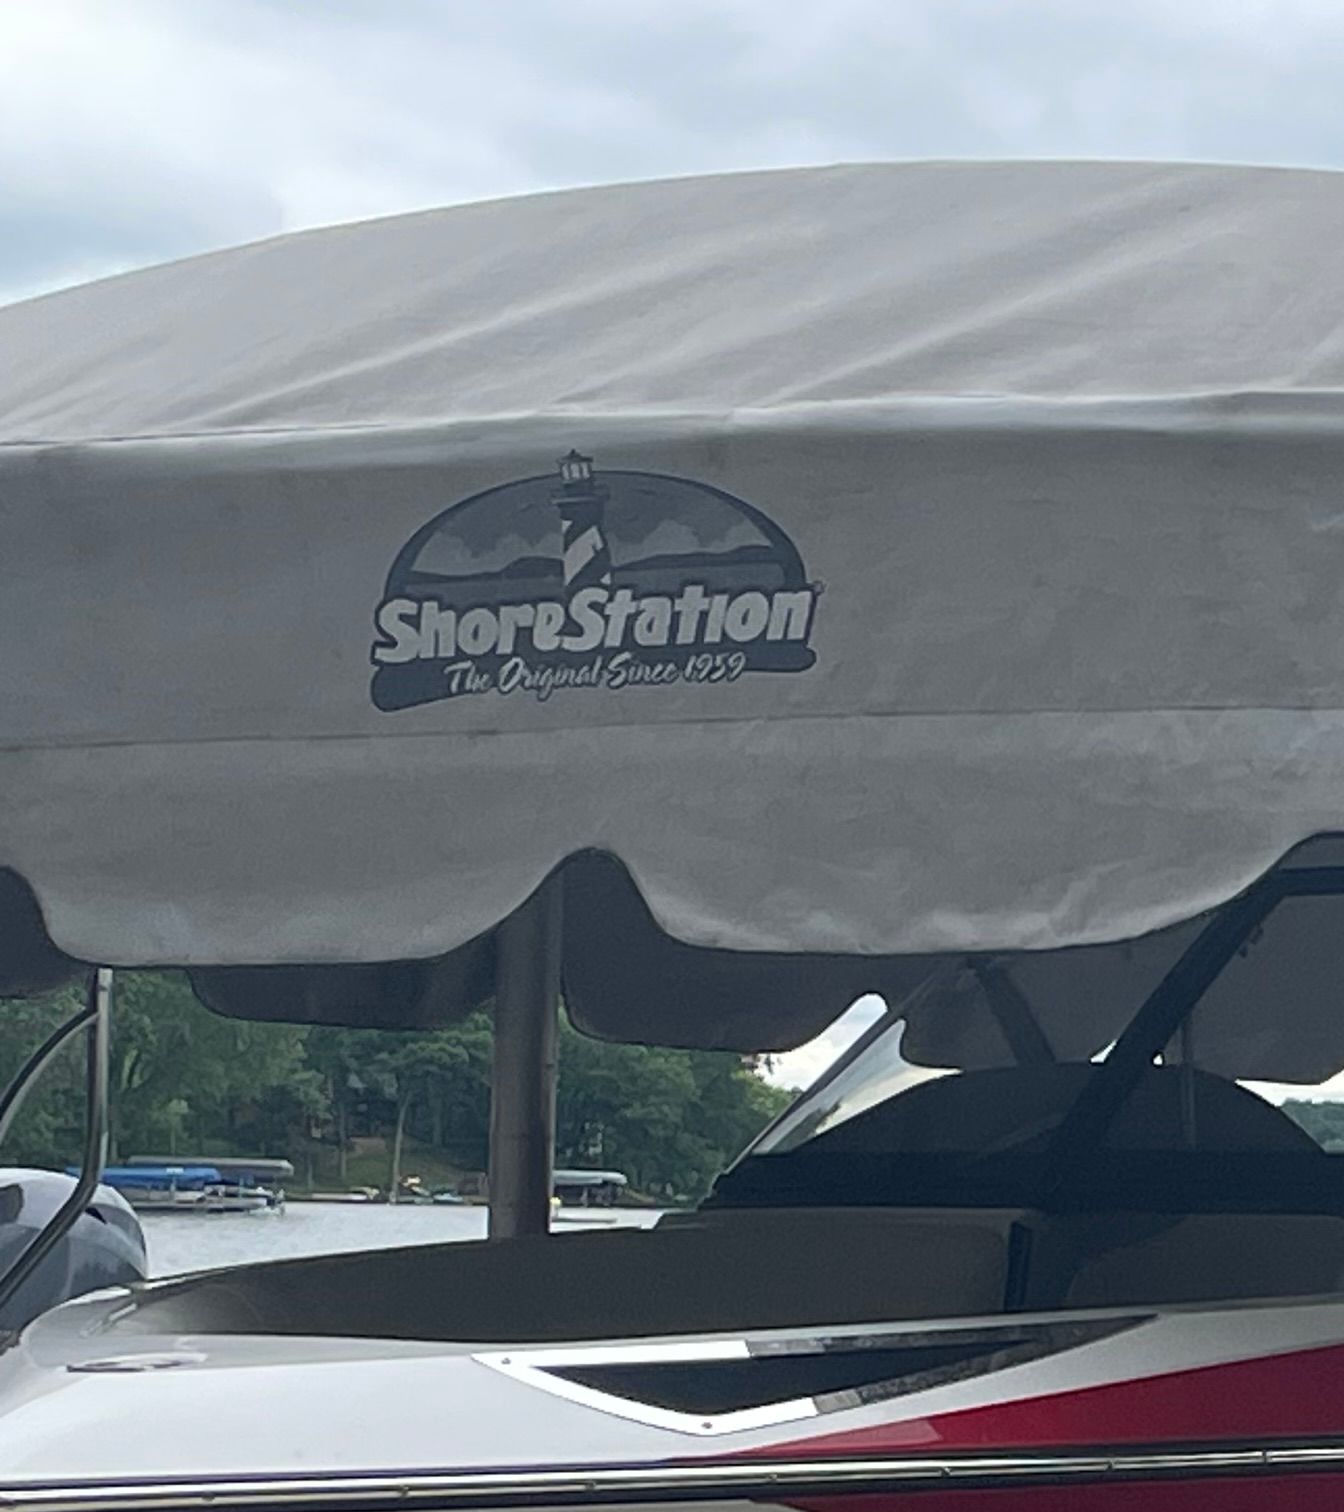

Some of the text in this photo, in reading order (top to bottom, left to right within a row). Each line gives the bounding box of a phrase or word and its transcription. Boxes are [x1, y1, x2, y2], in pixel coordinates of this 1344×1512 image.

[374, 585, 813, 662] ShoreStation
[444, 650, 747, 701] The Original Since 1959
